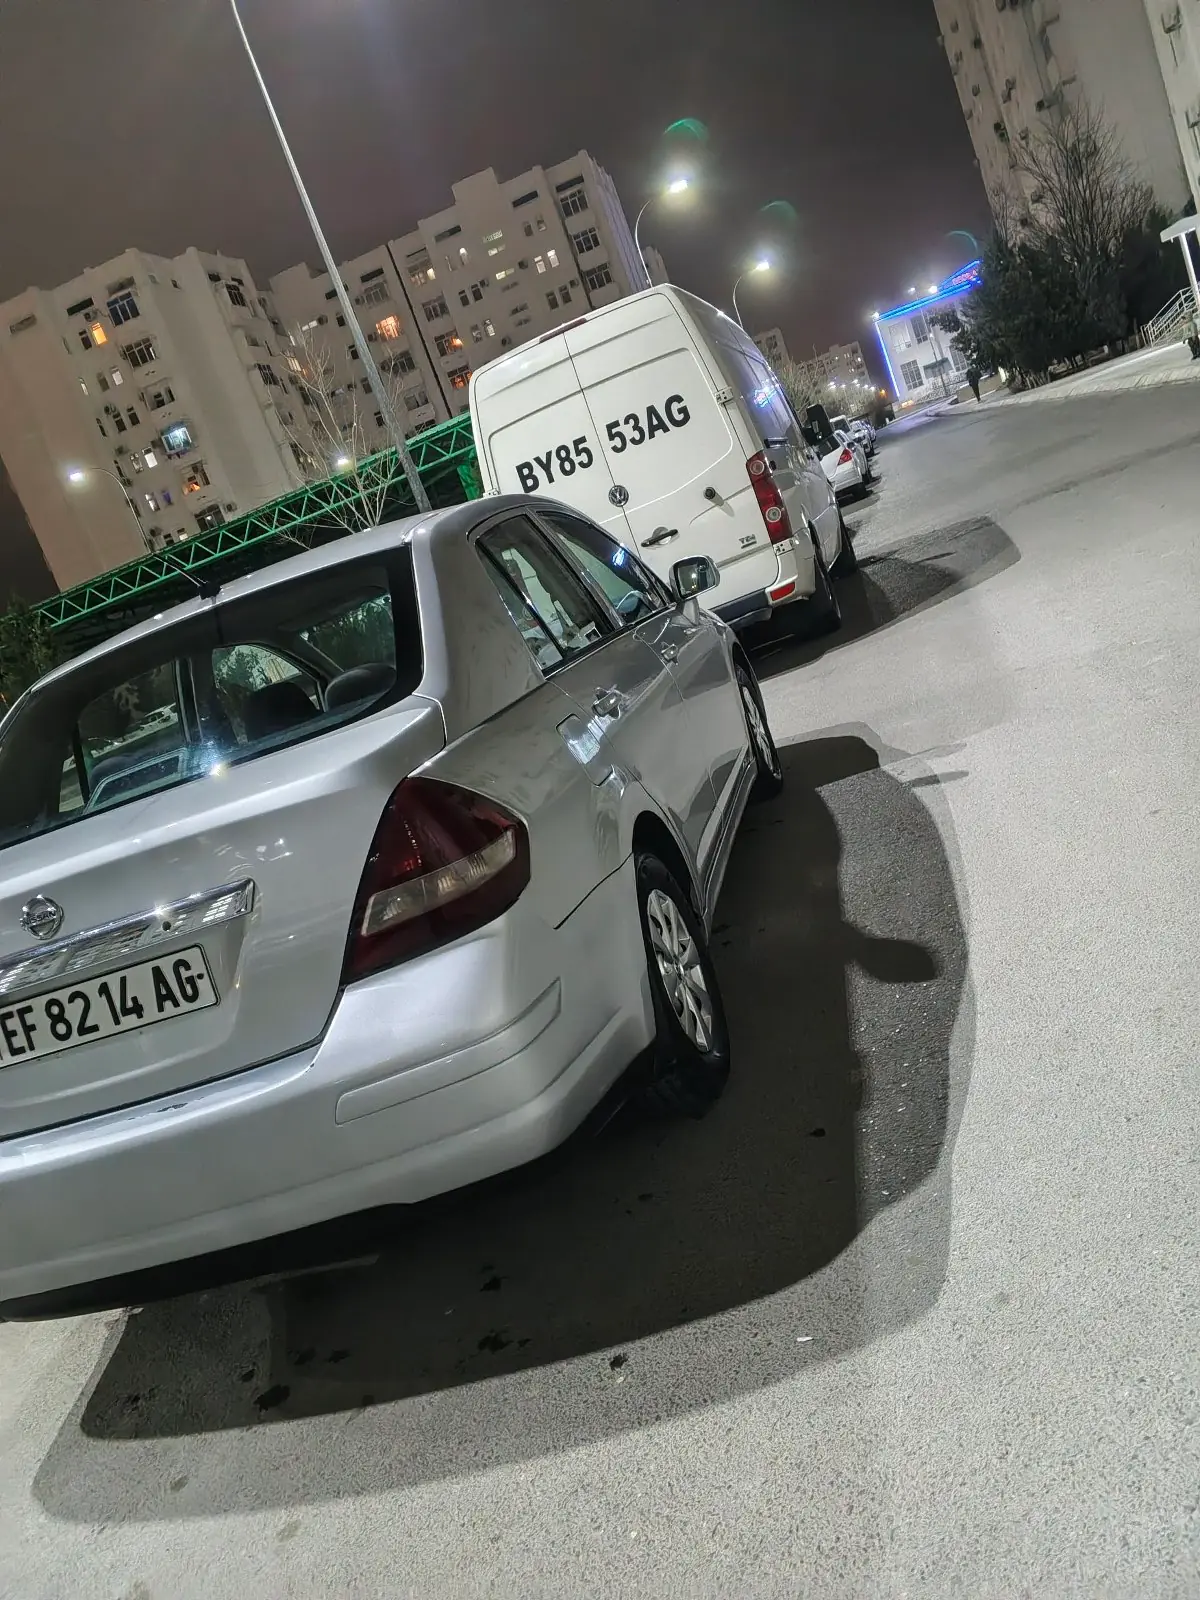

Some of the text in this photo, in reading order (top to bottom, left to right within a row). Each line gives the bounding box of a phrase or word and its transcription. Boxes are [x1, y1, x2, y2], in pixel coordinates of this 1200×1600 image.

[515, 394, 691, 494] BY85 53AG
[0, 1004, 37, 1057] EF
[151, 958, 200, 1013] AG
